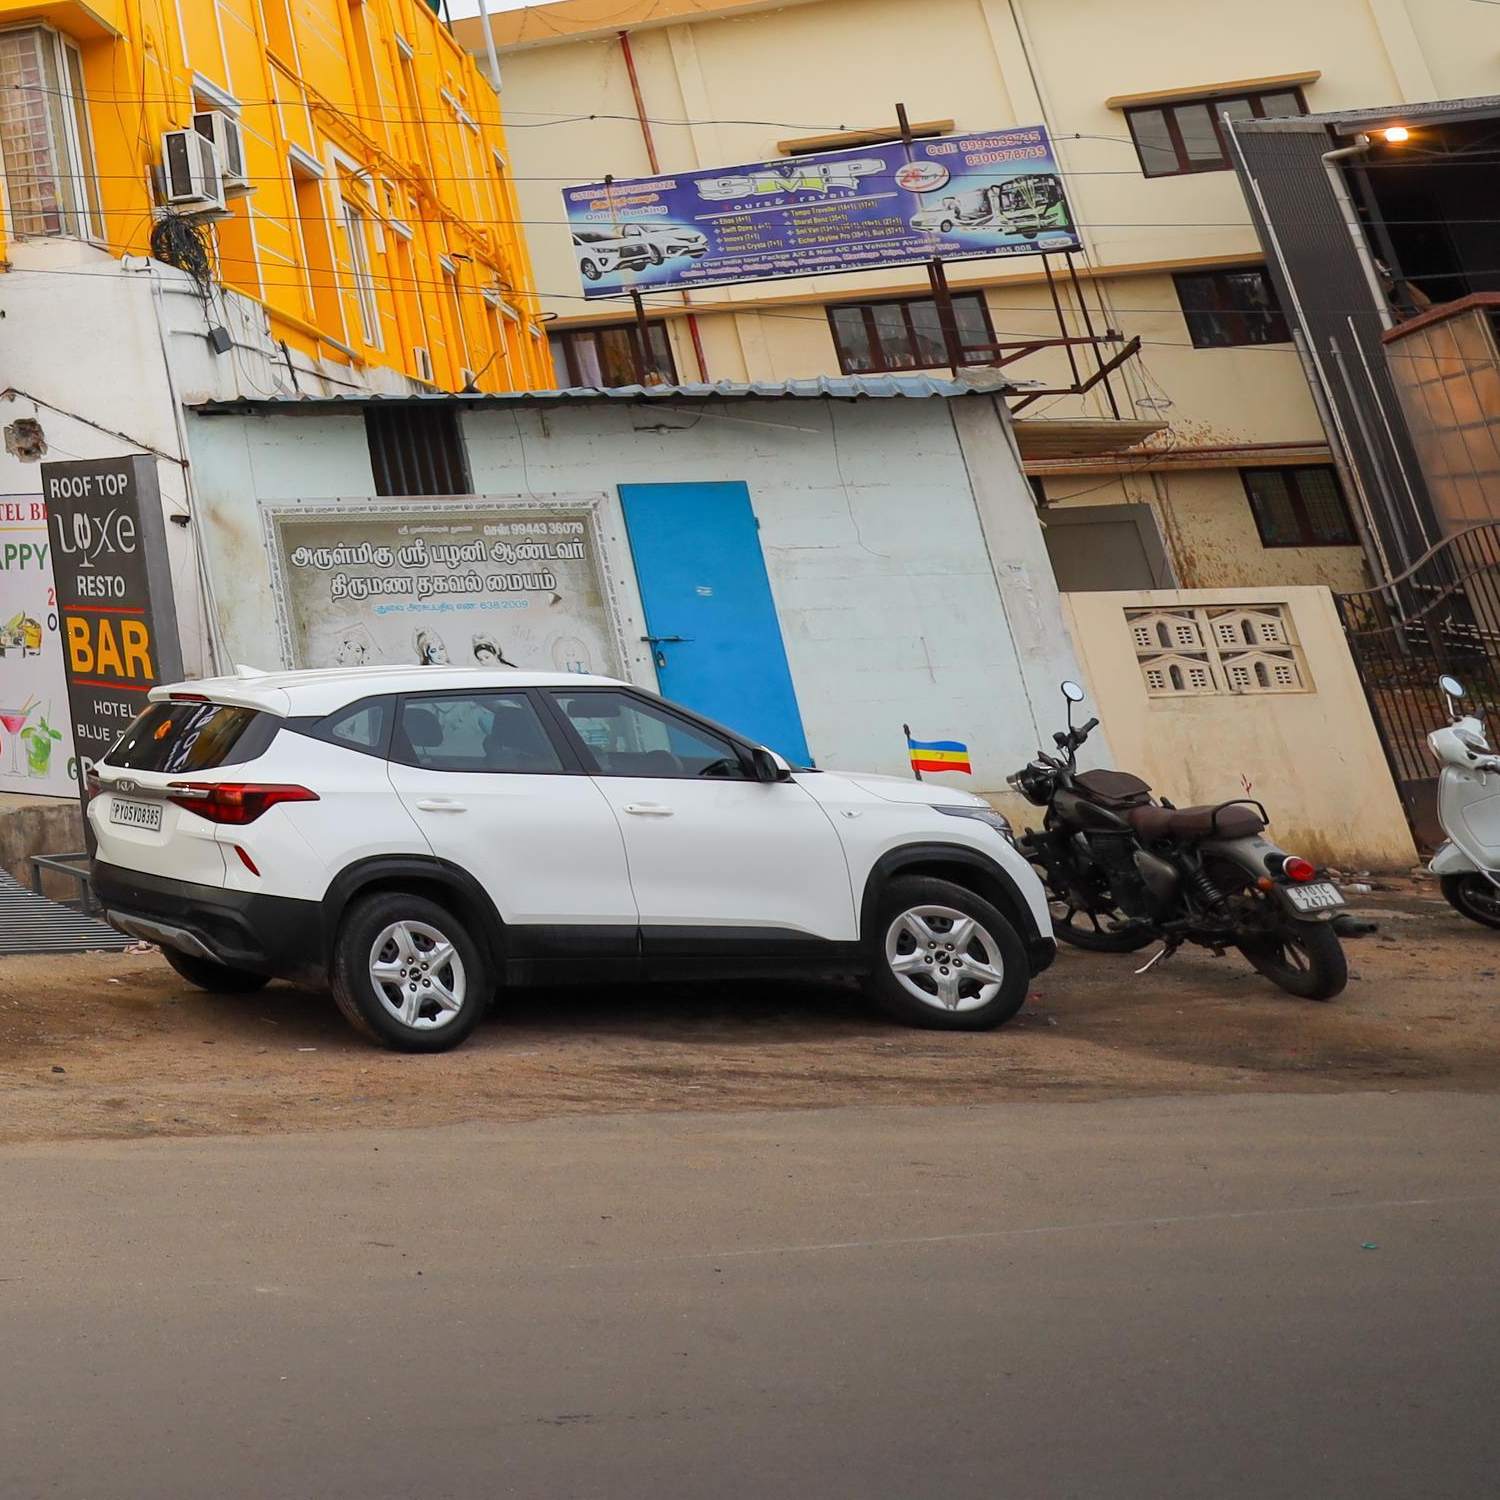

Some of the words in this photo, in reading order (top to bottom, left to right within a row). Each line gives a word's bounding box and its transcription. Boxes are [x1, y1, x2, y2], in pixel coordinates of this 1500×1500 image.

[864, 240, 899, 249] Vehicles
[51, 477, 92, 498] ROOF
[95, 473, 128, 496] TOP
[512, 522, 547, 535] 99443
[549, 522, 584, 534] 36079
[290, 541, 394, 570] அருள்மிகு
[397, 537, 430, 568] ஸ்ரீ
[432, 538, 488, 569] பழனி
[490, 536, 585, 564] ஆண்டவர்
[77, 575, 126, 597] RESTO
[331, 571, 414, 603] திருமண
[417, 569, 483, 602] தகவல்
[487, 567, 557, 593] மையம்
[66, 616, 154, 679] BAR
[94, 700, 136, 719] HOTEL
[77, 724, 110, 742] BLUE
